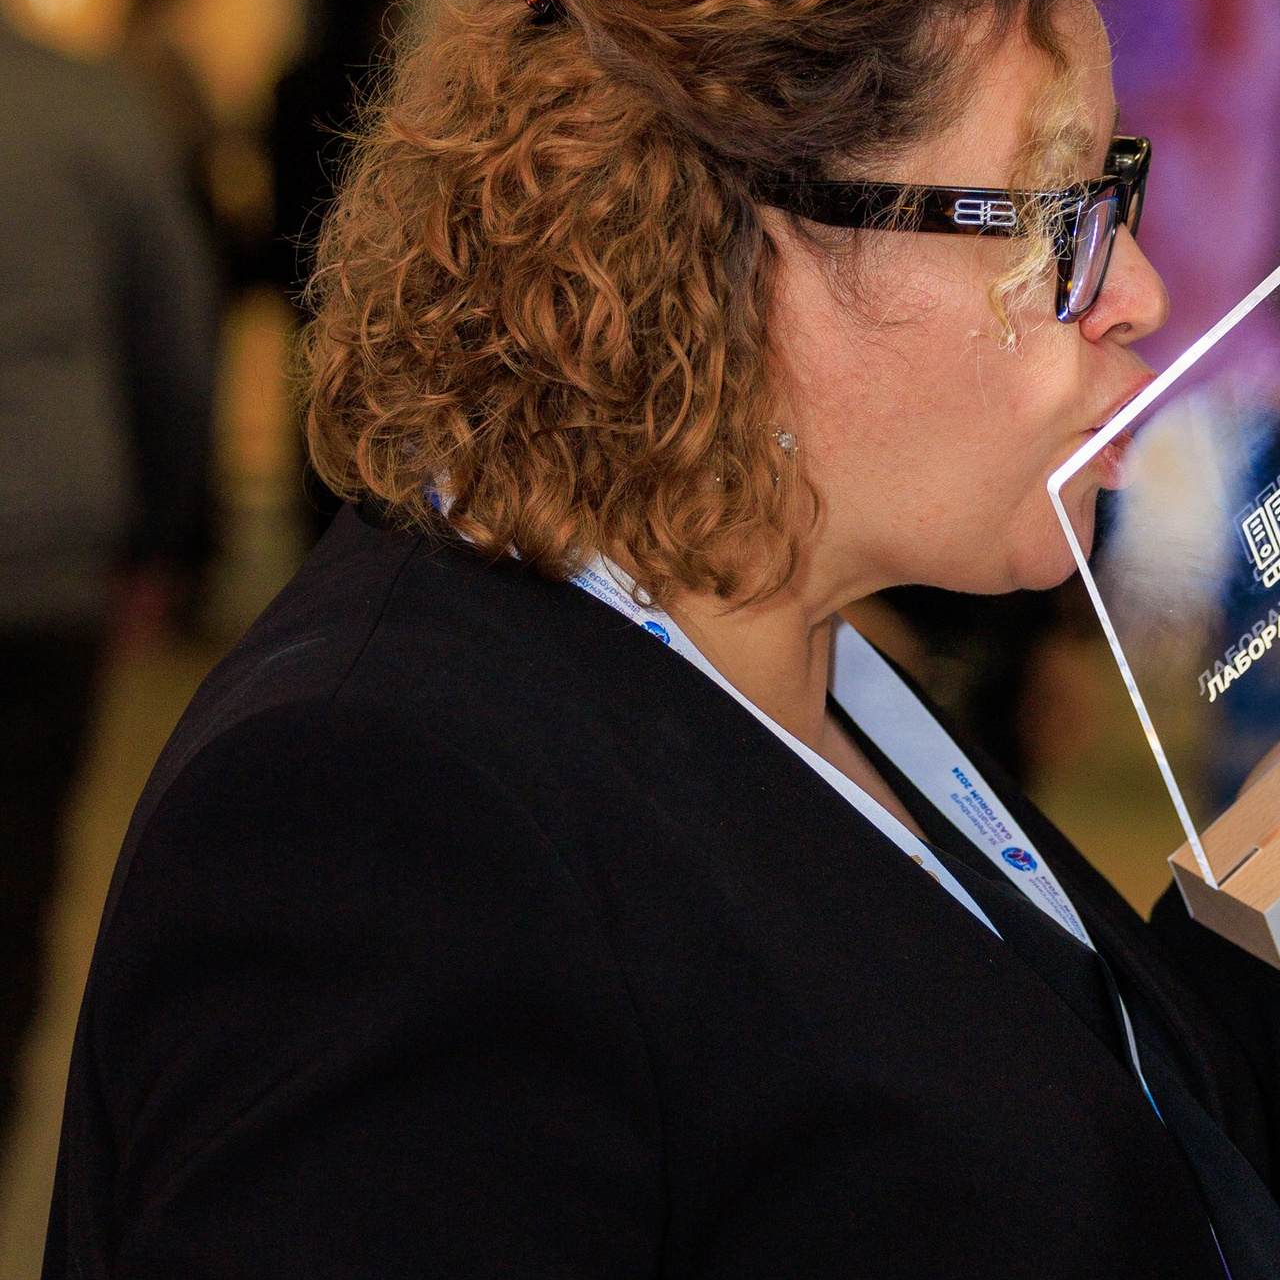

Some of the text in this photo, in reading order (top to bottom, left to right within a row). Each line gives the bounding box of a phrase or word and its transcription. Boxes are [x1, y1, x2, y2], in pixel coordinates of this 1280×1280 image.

[582, 566, 640, 614] тербургский
[950, 793, 988, 836] Petersburg
[951, 767, 1012, 840] GAS FORUM 2024
